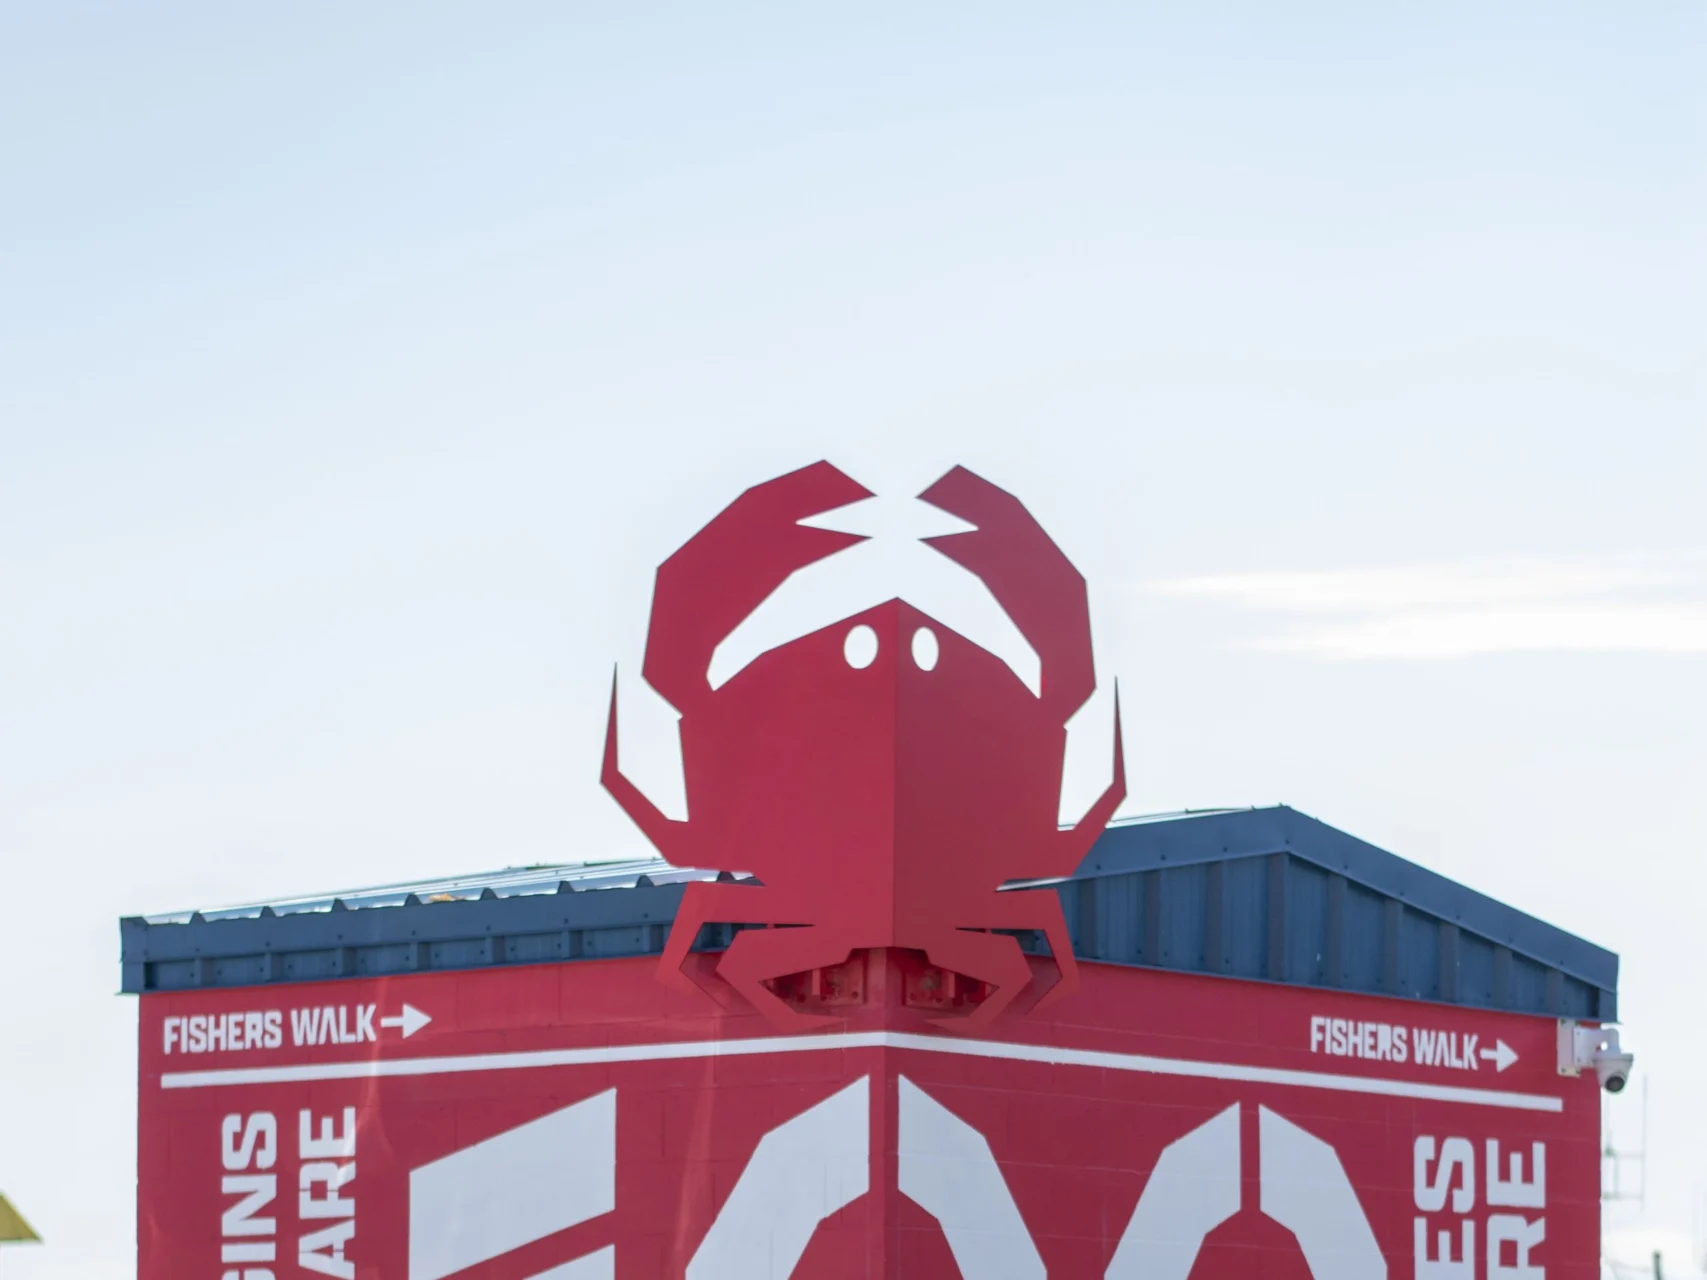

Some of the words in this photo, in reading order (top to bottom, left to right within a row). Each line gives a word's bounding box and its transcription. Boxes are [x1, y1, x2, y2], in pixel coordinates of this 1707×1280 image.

[164, 1010, 283, 1055] FISHERS
[290, 1003, 377, 1047] WALK
[1310, 1015, 1408, 1063] FISHERS
[1412, 1027, 1479, 1071] WALK
